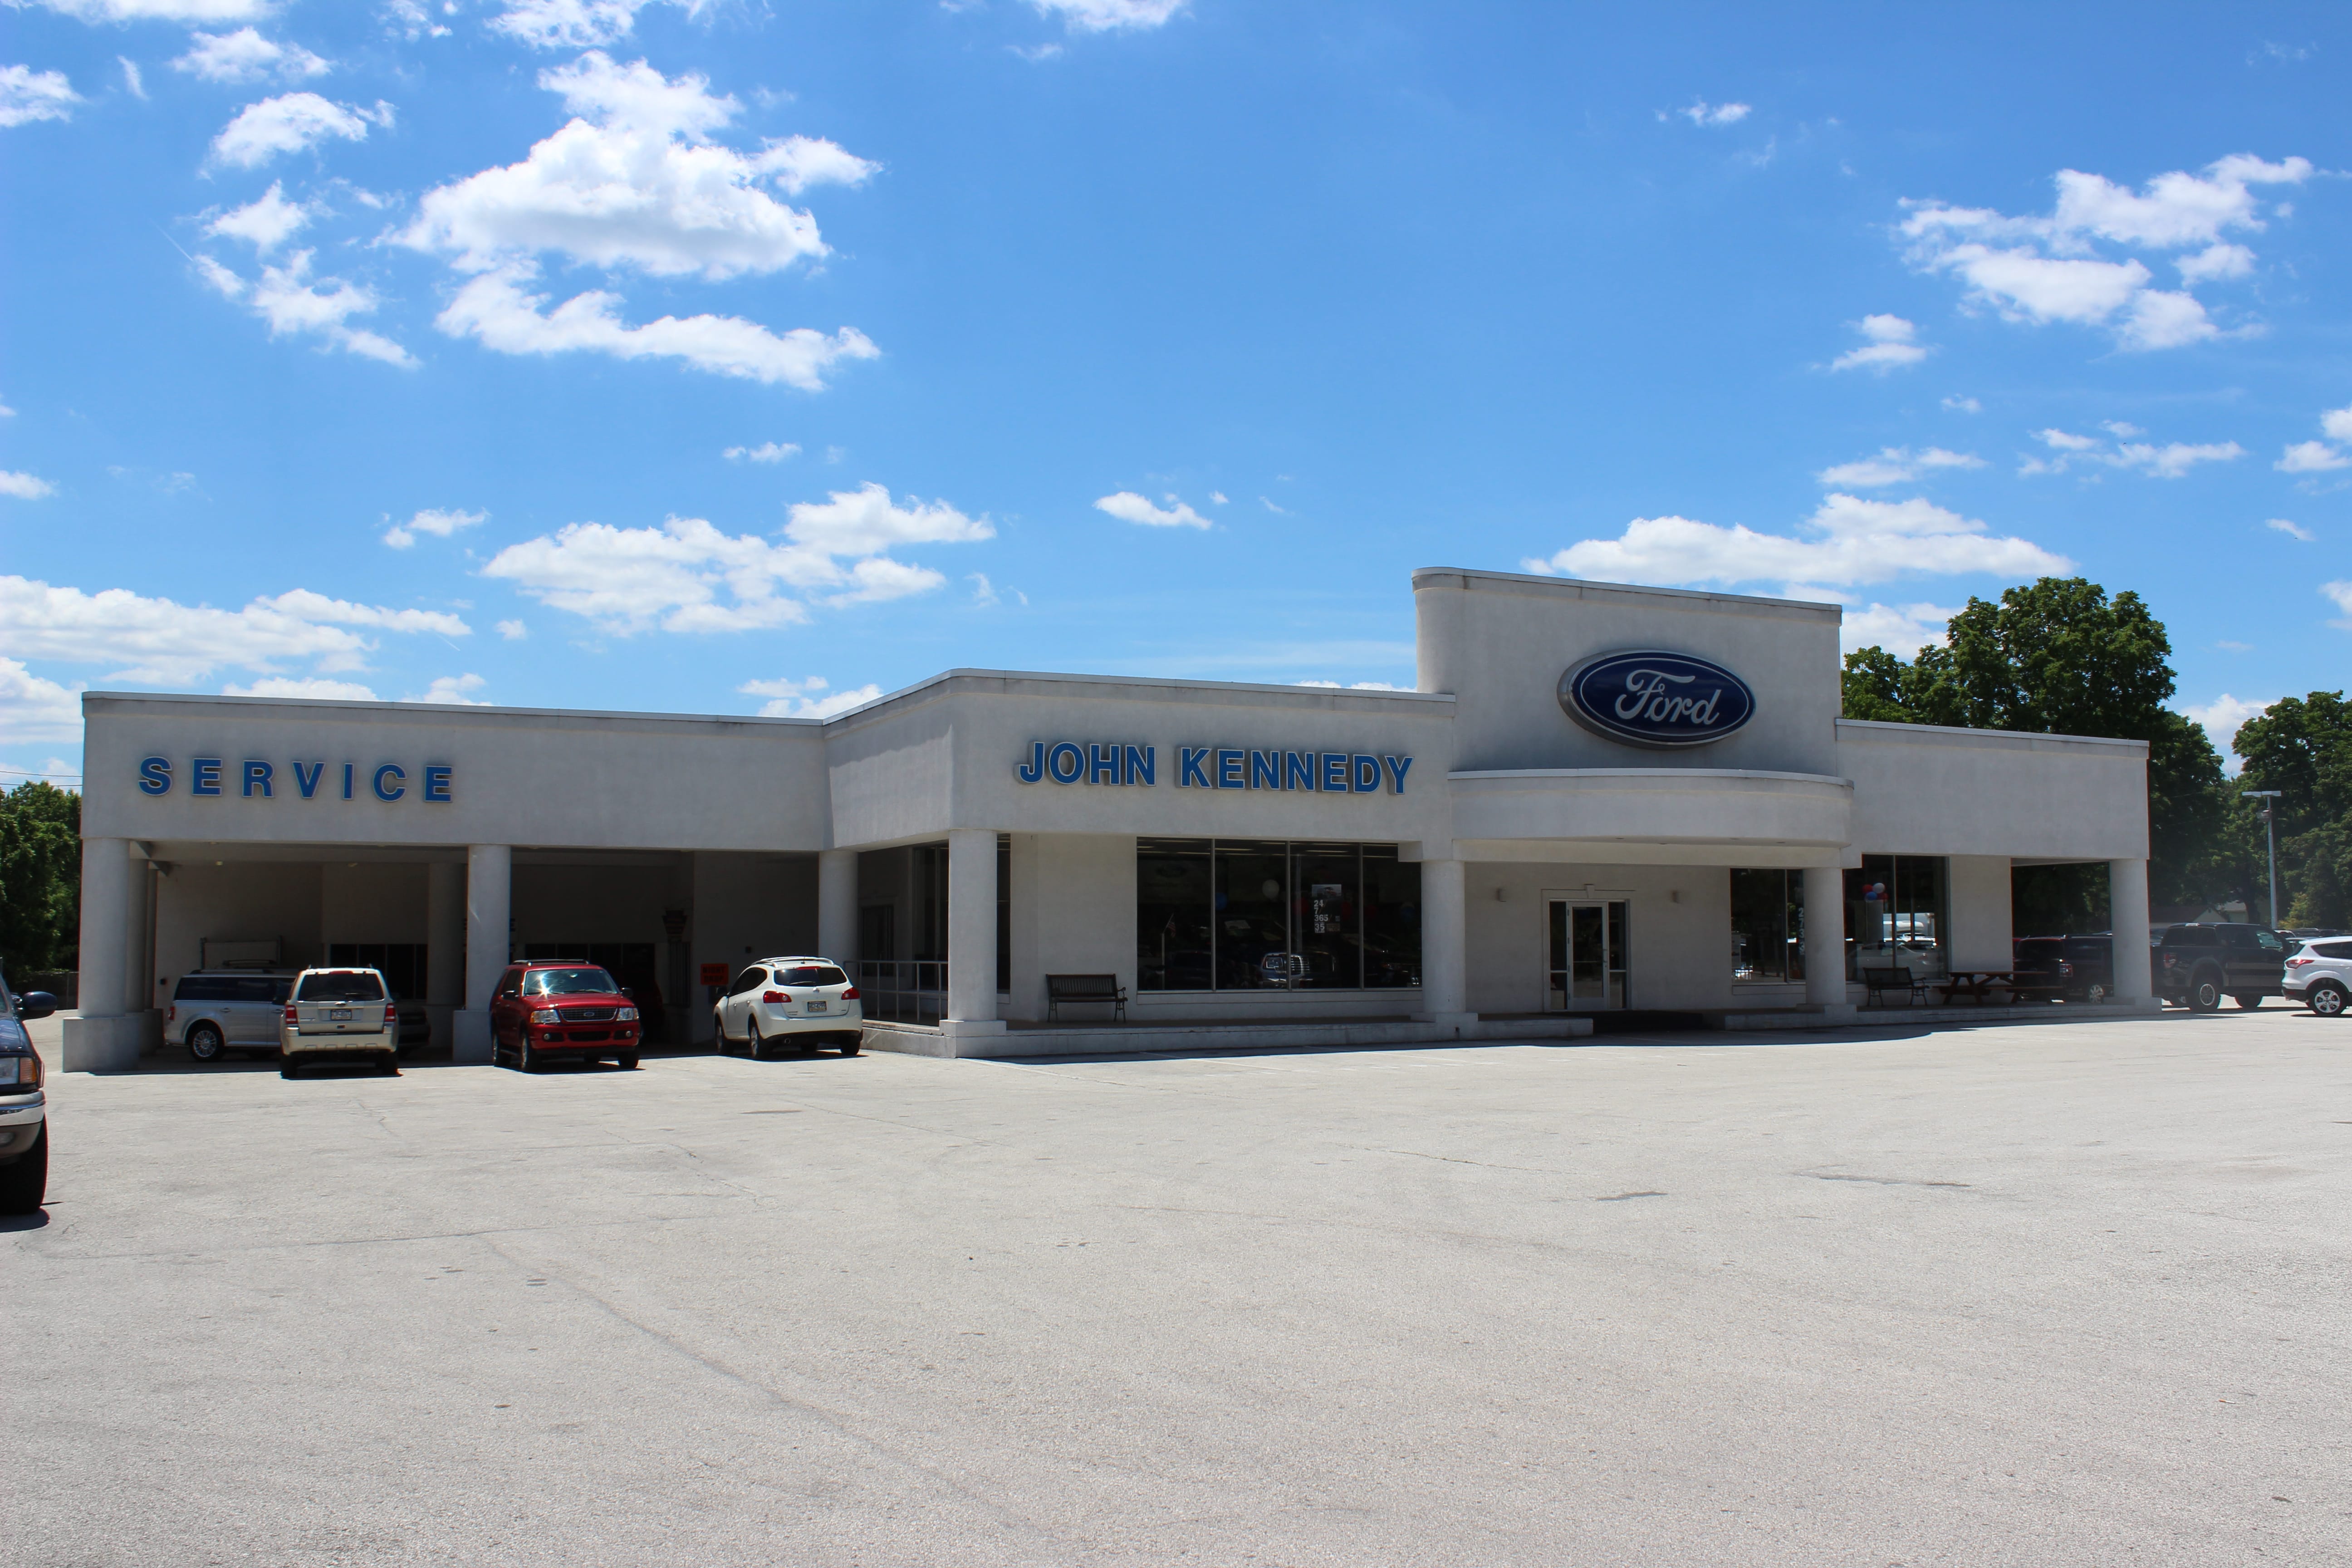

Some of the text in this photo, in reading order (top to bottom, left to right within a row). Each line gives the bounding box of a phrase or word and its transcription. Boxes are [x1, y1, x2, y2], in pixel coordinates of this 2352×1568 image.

[1615, 669, 1722, 725] Ford
[138, 756, 453, 803] SERVICE
[1017, 741, 1415, 795] JOHN KENNEDY
